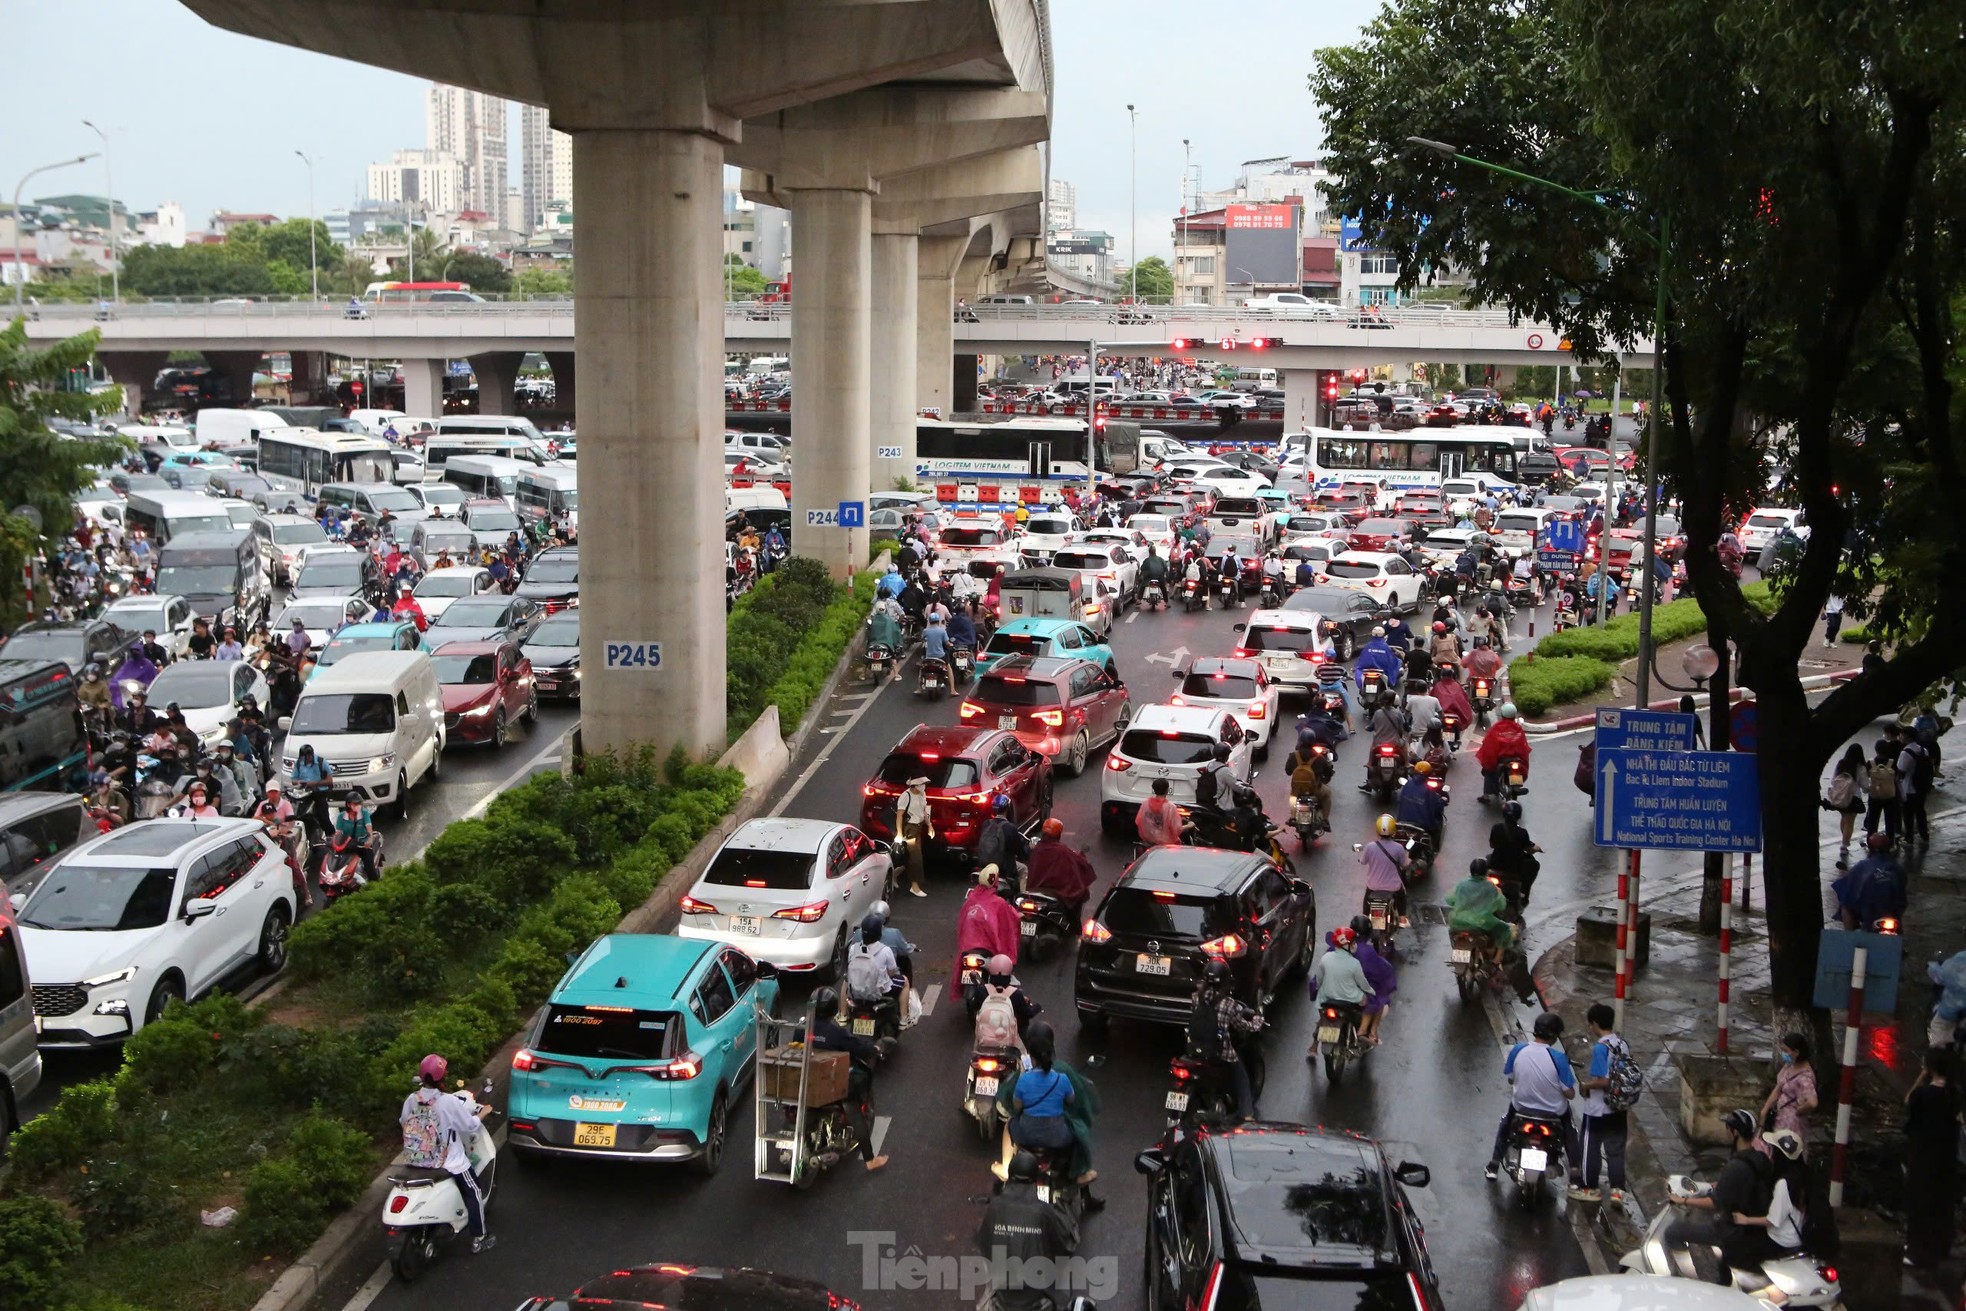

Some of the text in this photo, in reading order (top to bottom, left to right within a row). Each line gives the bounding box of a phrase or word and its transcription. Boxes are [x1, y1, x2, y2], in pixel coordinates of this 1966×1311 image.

[879, 448, 901, 457] P243
[935, 461, 1010, 471] LOGITEM VIETNAM
[608, 645, 661, 666] P245
[1627, 720, 1686, 735] TRUNG TÂM
[1626, 757, 1644, 769] NHÀ
[1645, 759, 1657, 770] THI
[1626, 773, 1640, 785] Bac
[1652, 774, 1670, 786] Liem
[1672, 775, 1695, 787] Indoor
[1697, 776, 1728, 789] Stadium
[1647, 816, 1666, 829] THAO
[1617, 831, 1756, 847] National Sports Training Center Ha Noi
[1147, 956, 1160, 965] 30K
[588, 1125, 604, 1135] 29E
[578, 1135, 611, 1145] 069.75
